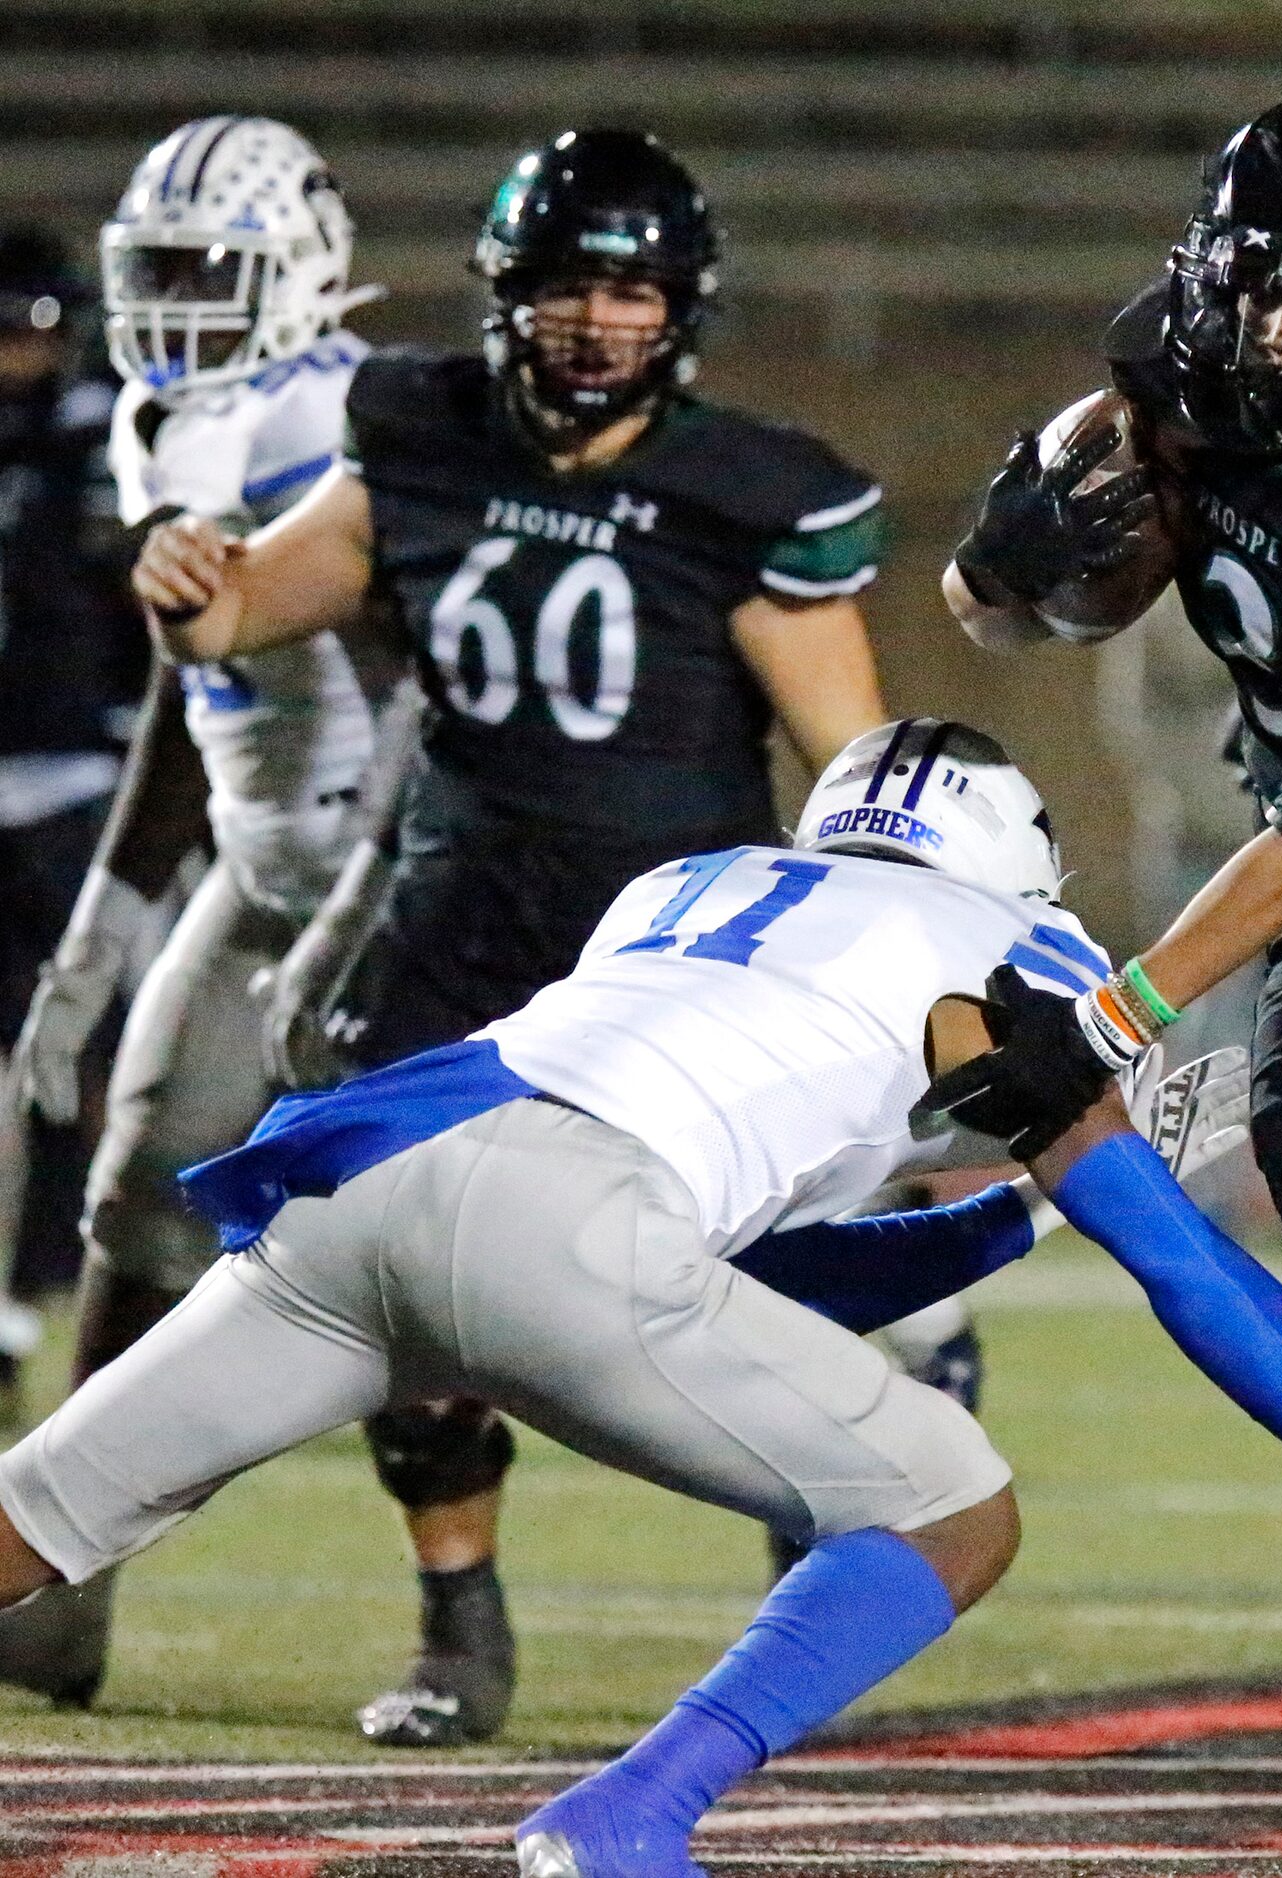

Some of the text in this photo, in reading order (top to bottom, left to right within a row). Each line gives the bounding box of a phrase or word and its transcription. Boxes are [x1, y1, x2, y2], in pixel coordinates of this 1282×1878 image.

[484, 498, 617, 551] PROSPER
[430, 536, 636, 741] 60
[942, 768, 969, 795] 11
[817, 807, 945, 851] GOPHERS
[613, 848, 836, 967] 11
